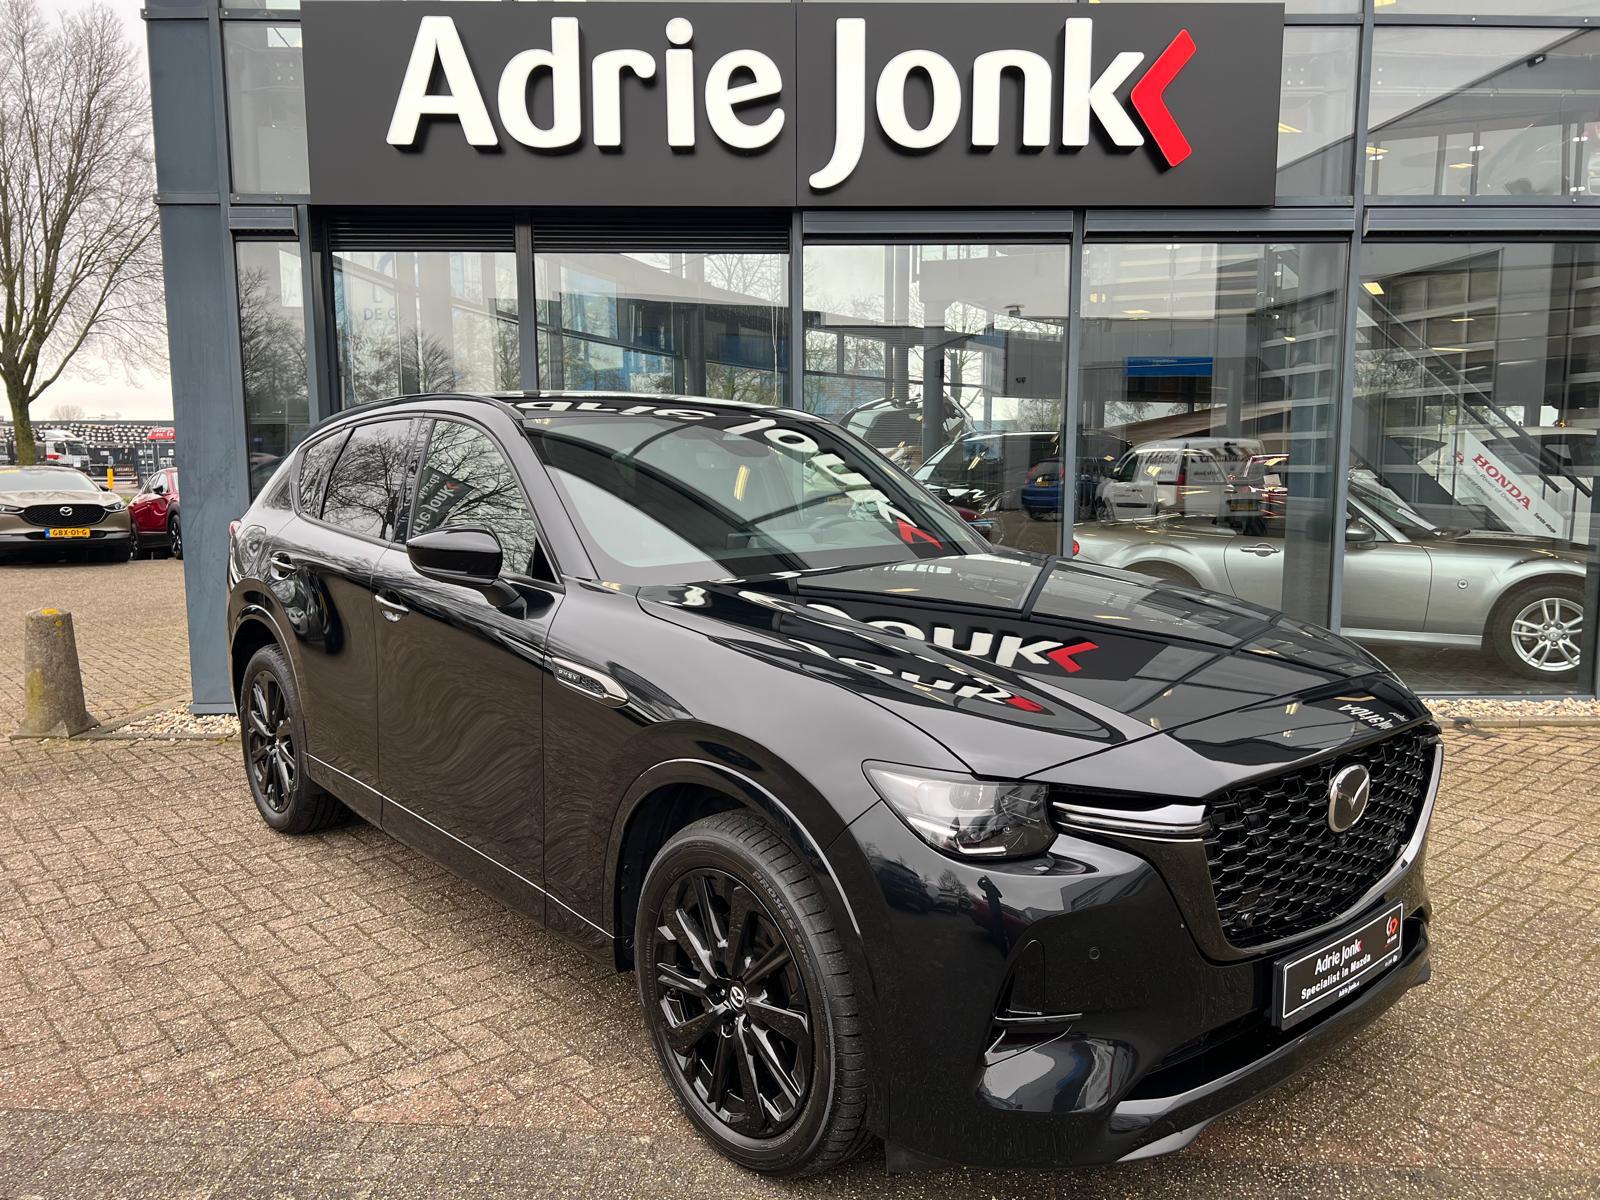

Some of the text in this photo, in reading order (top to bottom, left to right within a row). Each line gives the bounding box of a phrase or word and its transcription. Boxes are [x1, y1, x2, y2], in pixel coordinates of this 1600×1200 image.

[385, 15, 1146, 190] Adrie Jonk
[1472, 453, 1532, 510] HONDA
[52, 529, 87, 538] GBX-01-G
[1301, 970, 1340, 1000] Specialist
[1341, 967, 1349, 978] in
[1350, 953, 1371, 973] Mazda
[1315, 950, 1341, 976] Adrie
[1339, 939, 1362, 967] Jonk
